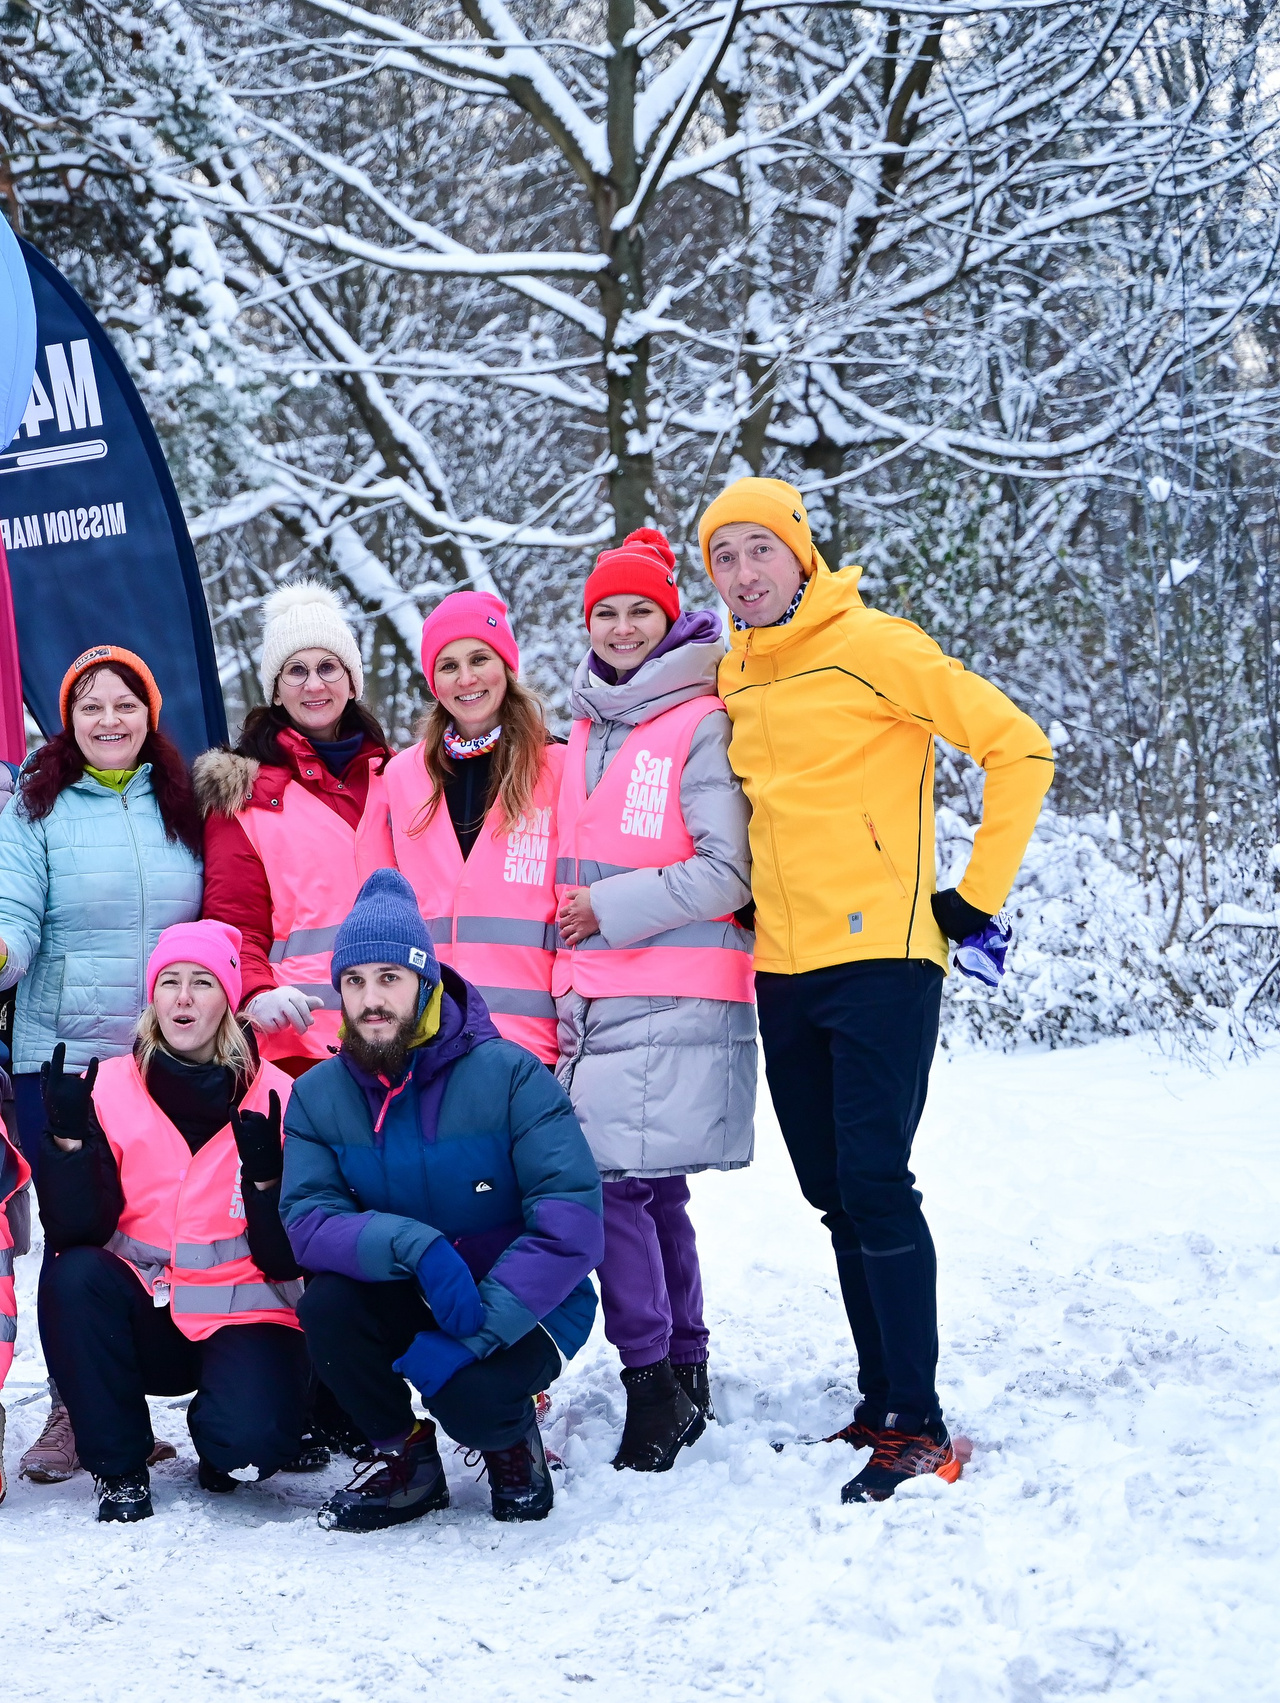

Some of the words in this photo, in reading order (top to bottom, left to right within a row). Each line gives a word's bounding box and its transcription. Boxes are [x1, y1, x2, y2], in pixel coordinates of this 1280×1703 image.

[630, 749, 673, 789] Sat
[625, 781, 668, 814] 9AM
[620, 807, 664, 840] 5KM
[506, 831, 549, 861] 9AM
[503, 856, 547, 886] 5KM
